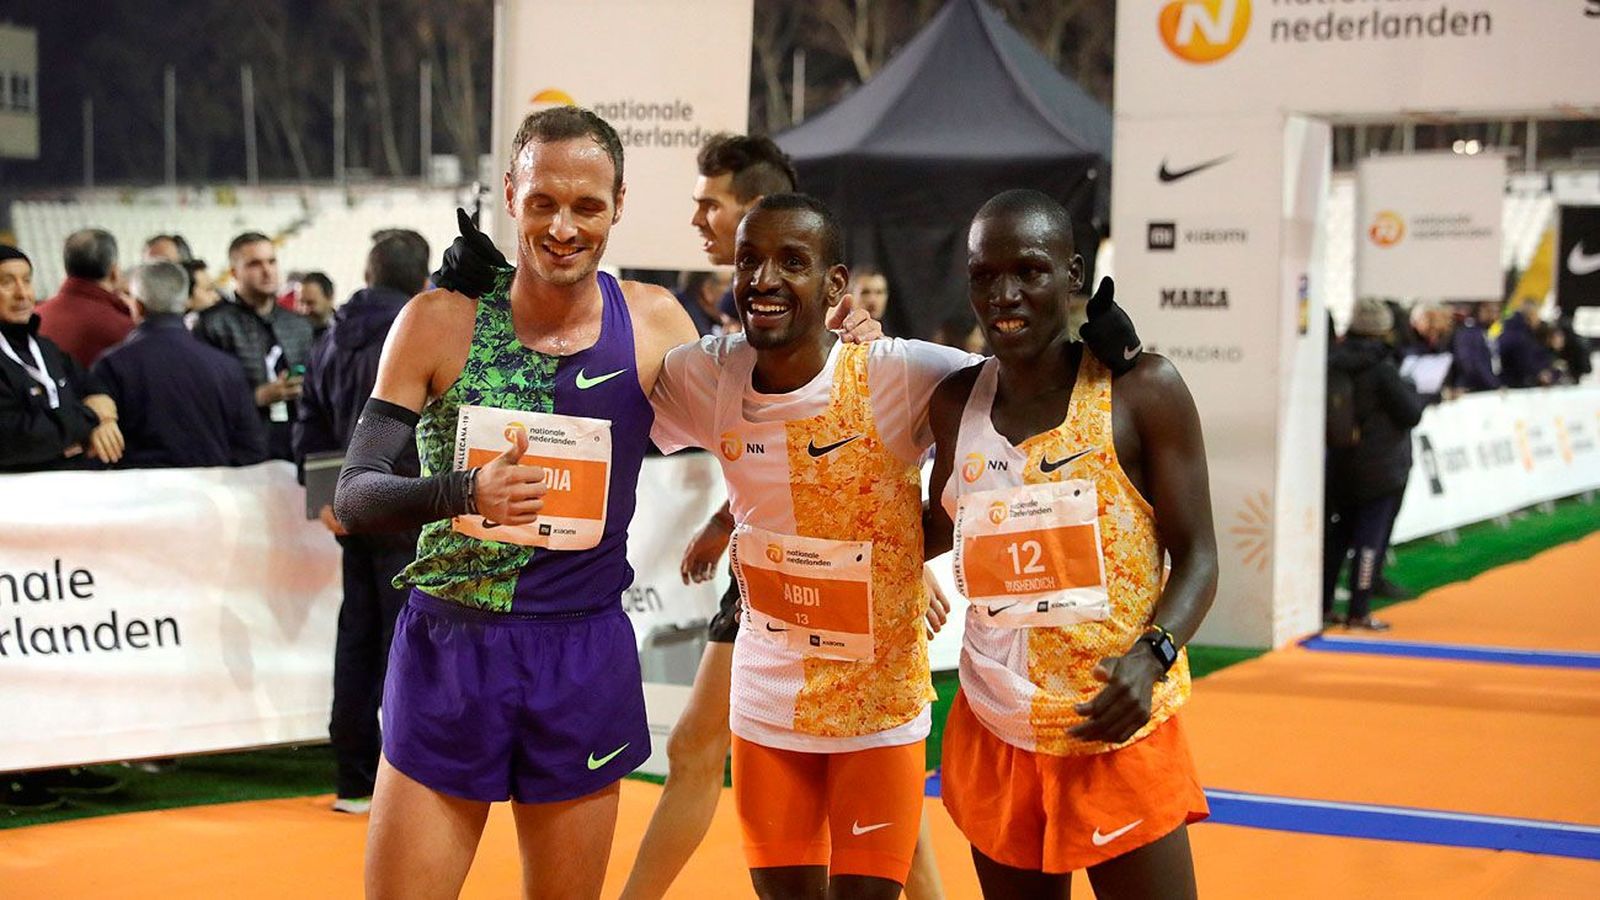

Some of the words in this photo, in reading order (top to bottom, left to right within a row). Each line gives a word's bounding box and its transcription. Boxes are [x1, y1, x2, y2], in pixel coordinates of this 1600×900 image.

[1270, 8, 1493, 42] nederlanden
[594, 99, 694, 121] nationale
[620, 126, 713, 149] derlande
[1160, 288, 1229, 309] MARCA
[528, 434, 577, 446] nederlanden
[529, 427, 566, 437] nationale
[746, 443, 765, 454] NN
[987, 460, 1008, 471] NN
[543, 467, 571, 492] DIA
[786, 550, 820, 560] nationale
[786, 557, 832, 567] nederlanden
[1007, 540, 1046, 575] 12
[783, 582, 820, 607] ABDI
[794, 612, 810, 625] 13
